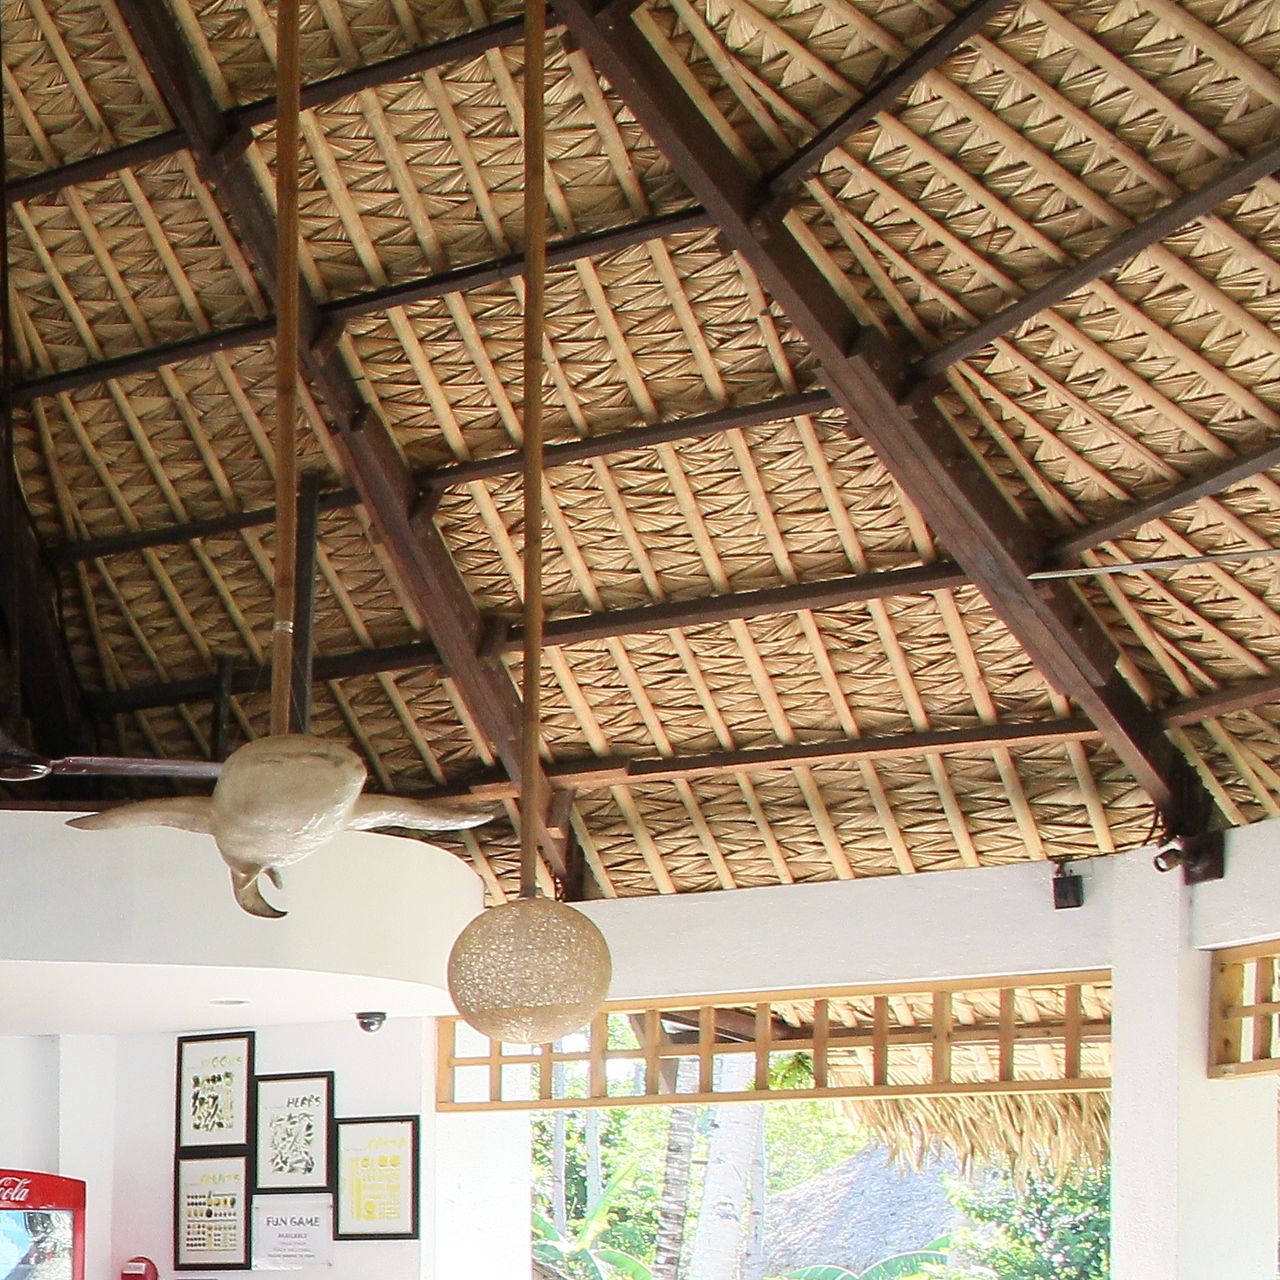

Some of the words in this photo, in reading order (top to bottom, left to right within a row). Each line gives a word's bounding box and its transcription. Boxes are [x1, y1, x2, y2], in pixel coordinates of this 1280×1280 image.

[287, 1095, 322, 1108] HERBS
[266, 1216, 287, 1226] FUN
[290, 1216, 320, 1227] GAME
